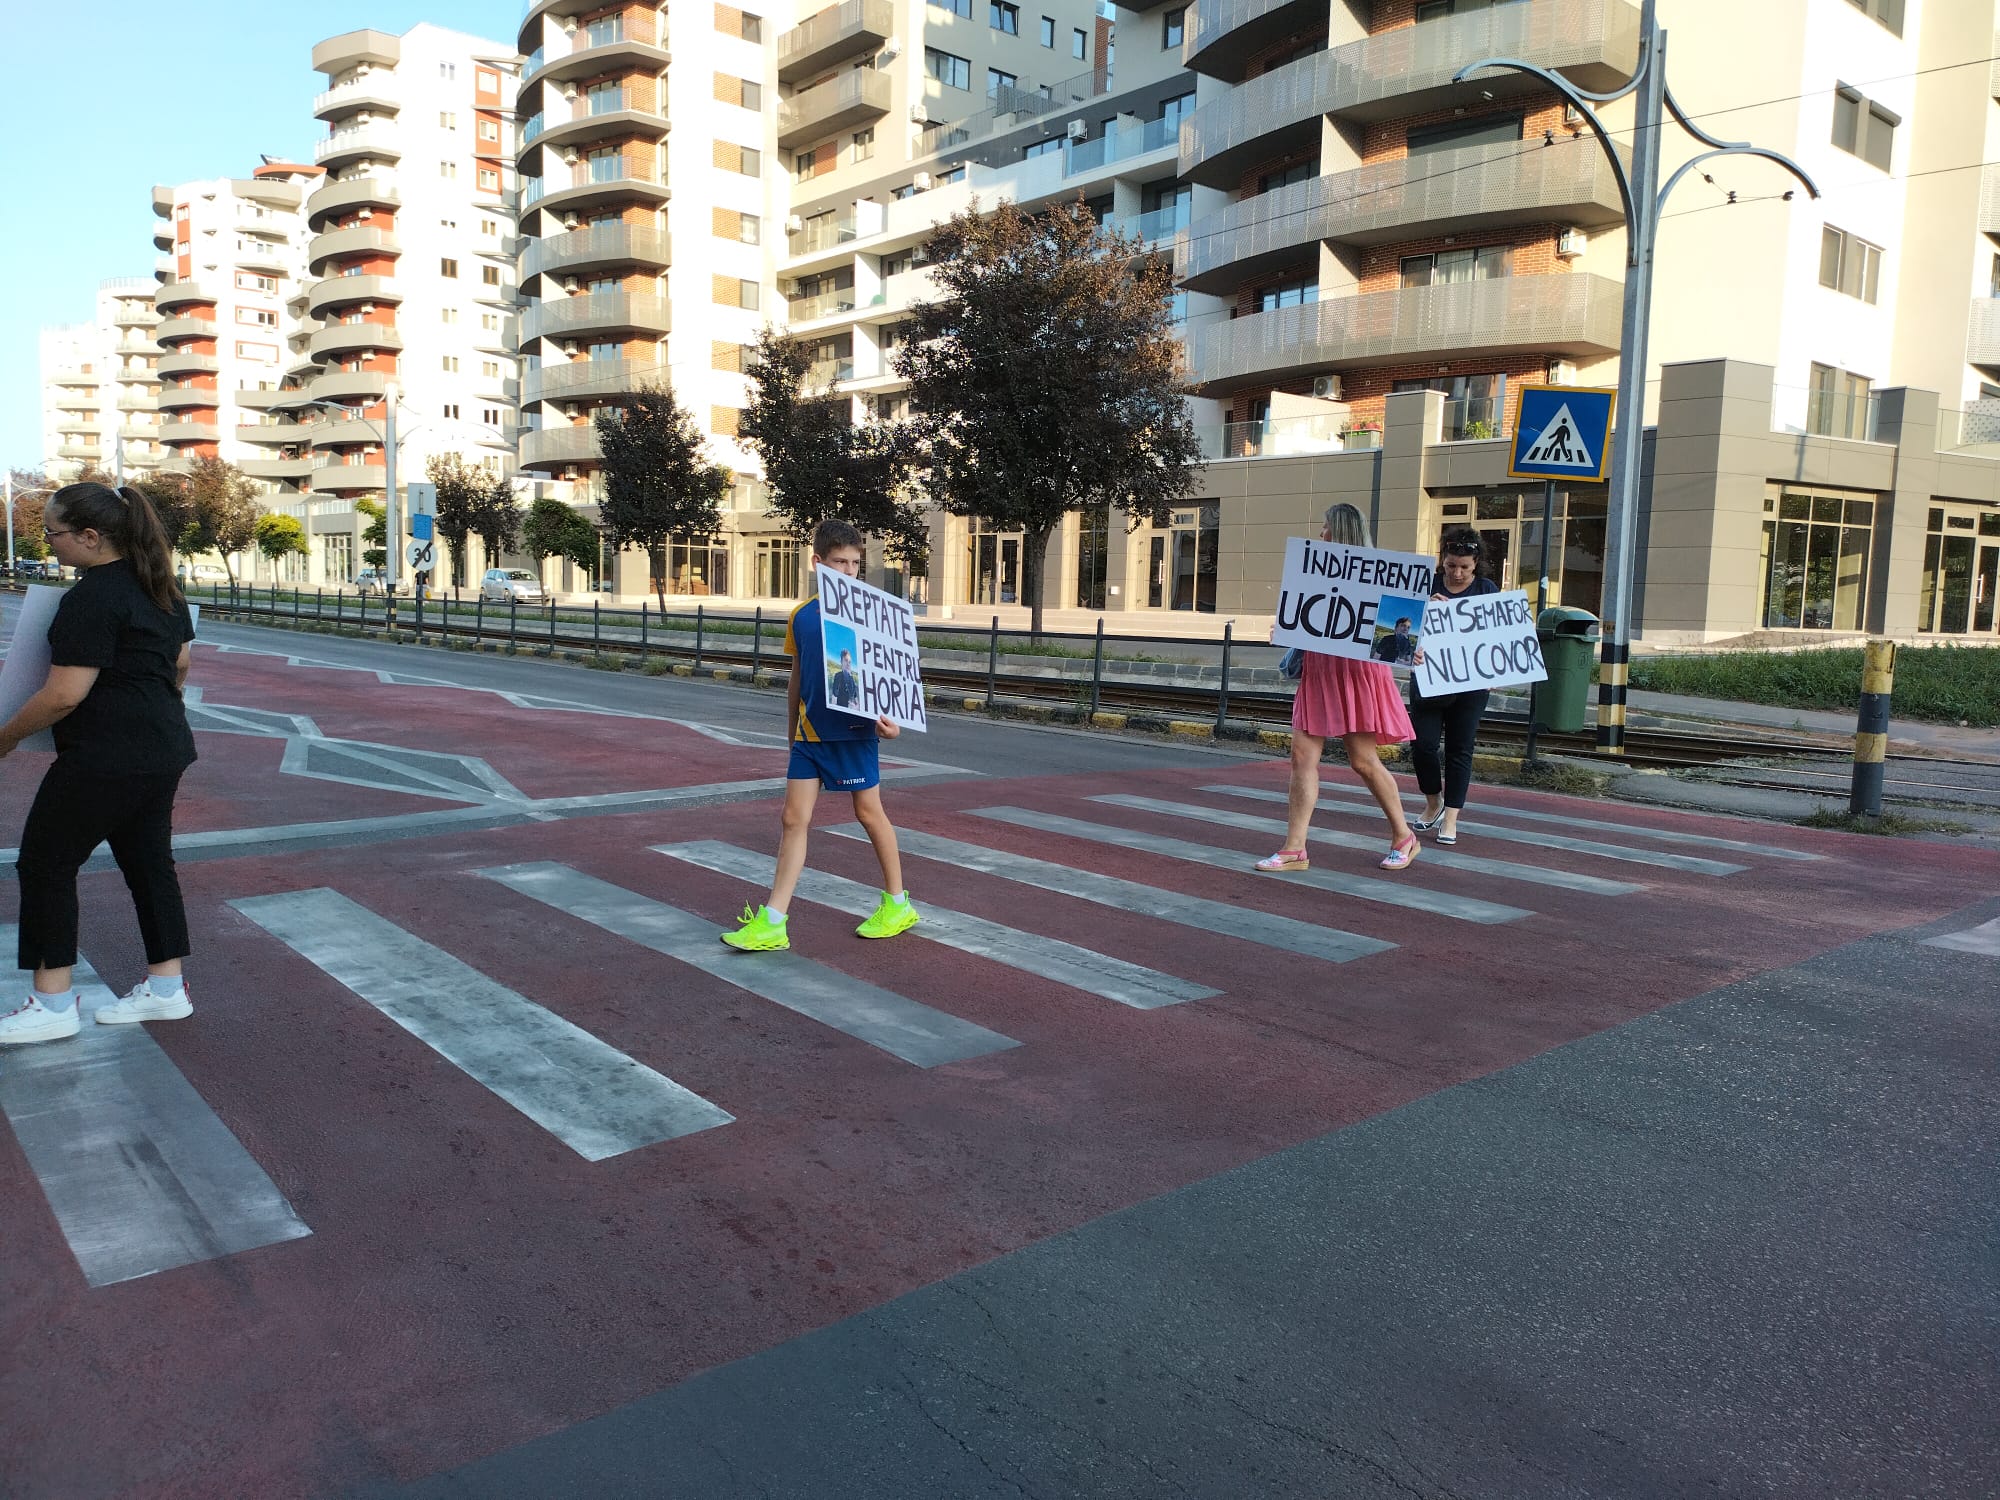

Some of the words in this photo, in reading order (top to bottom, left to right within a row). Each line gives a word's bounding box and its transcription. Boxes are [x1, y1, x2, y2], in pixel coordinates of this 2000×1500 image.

[414, 548, 432, 563] 30
[822, 573, 913, 647] DREPTATE
[1278, 587, 1379, 645] UCIDE
[1455, 598, 1533, 634] SEMAFOR
[862, 639, 922, 684] PENTRU
[1424, 646, 1470, 685] NU
[1473, 635, 1545, 679] COVOR
[862, 670, 925, 724] HORIA
